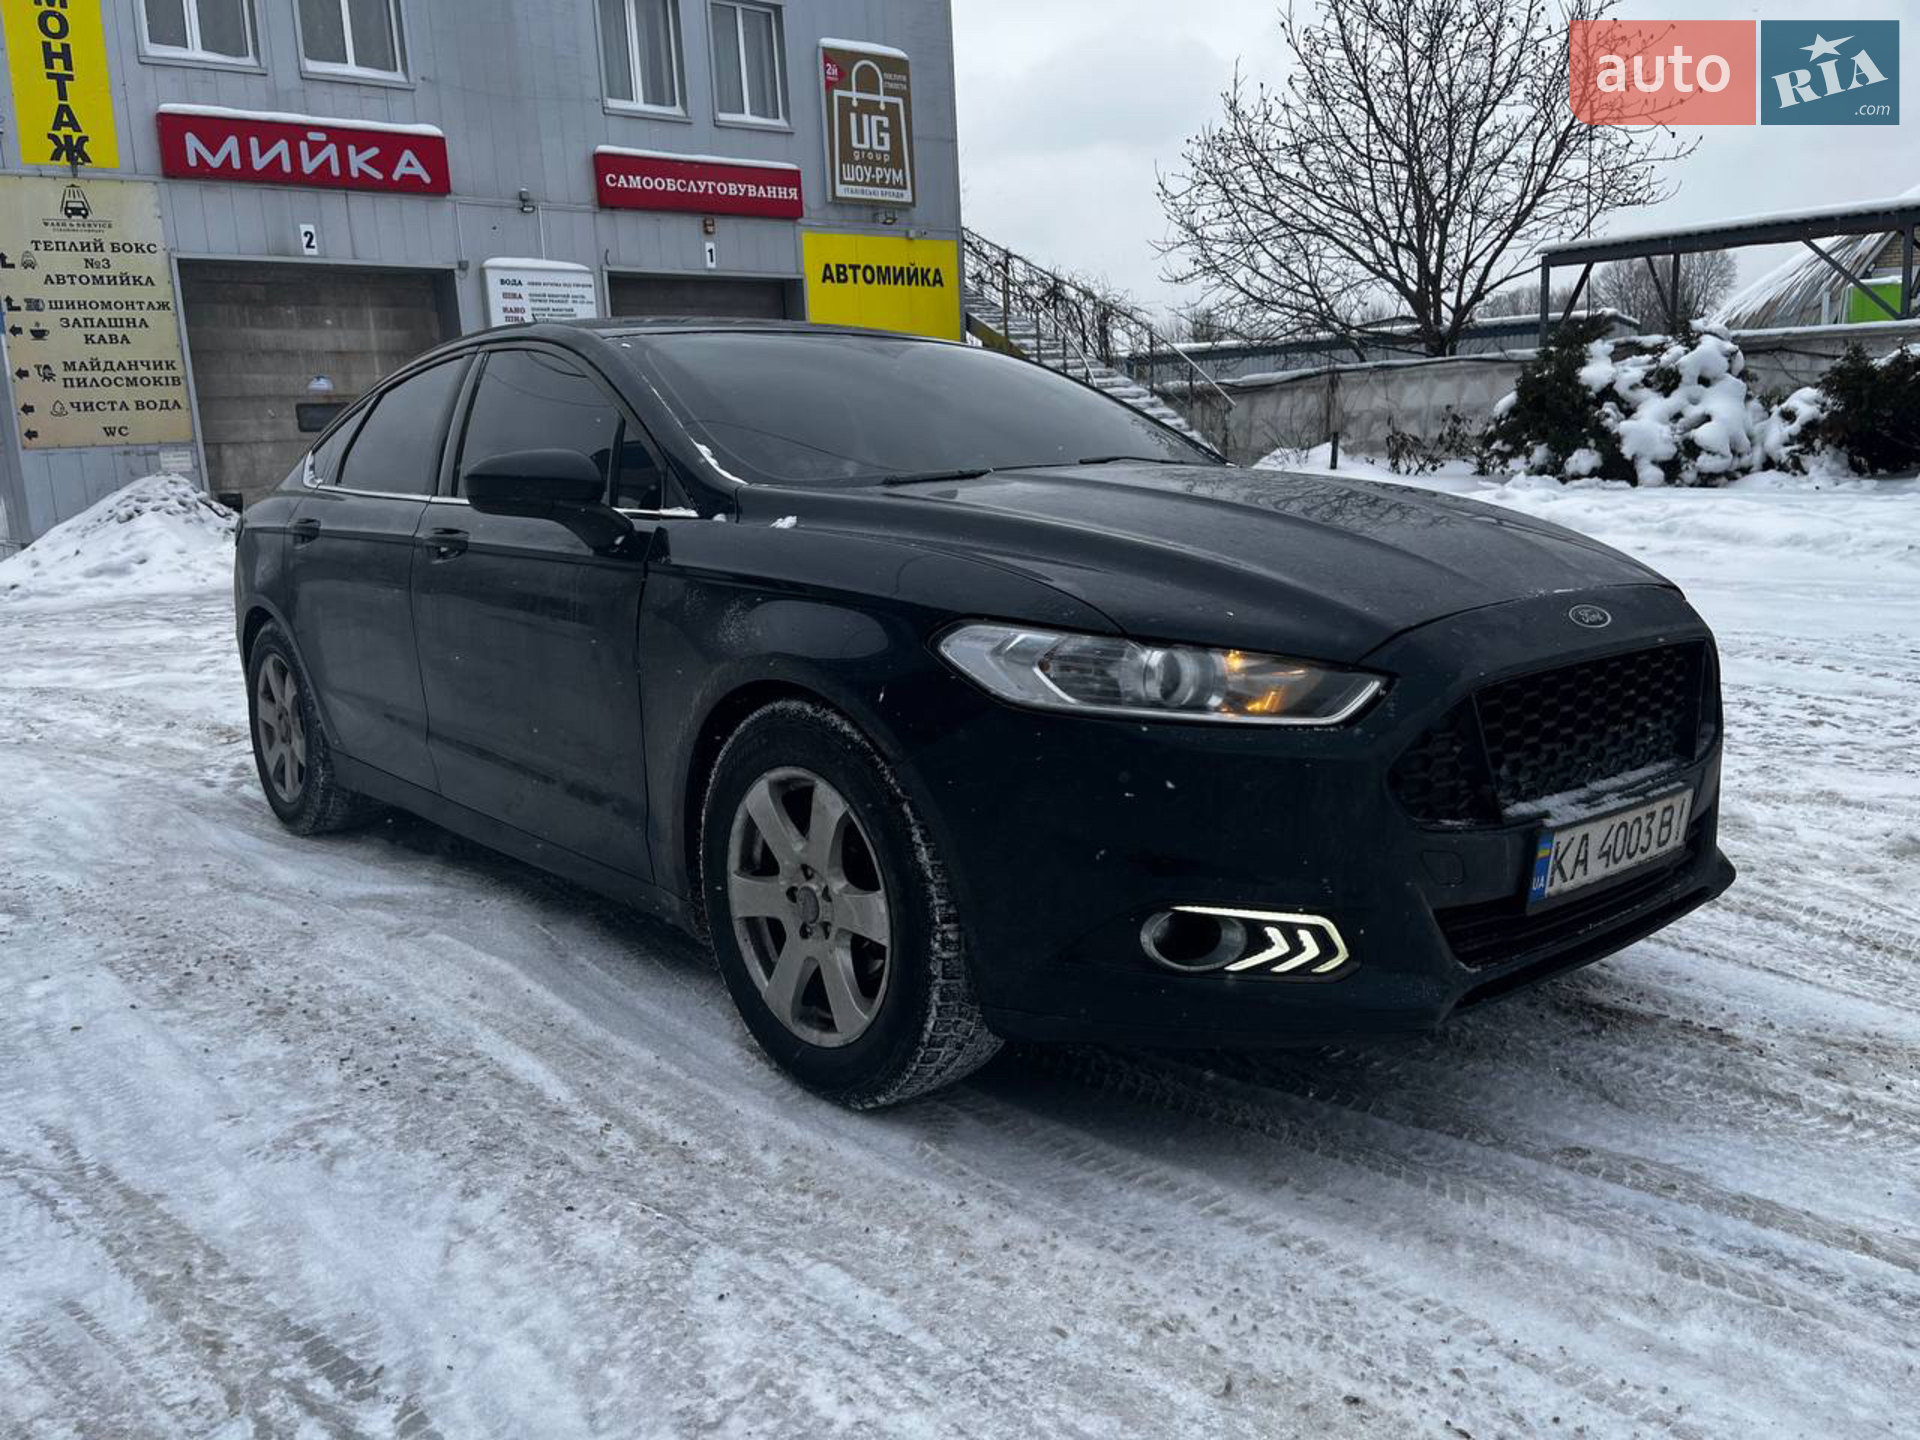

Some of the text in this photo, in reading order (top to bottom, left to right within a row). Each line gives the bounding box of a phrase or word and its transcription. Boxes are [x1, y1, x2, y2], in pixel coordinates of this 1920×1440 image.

[34, 0, 92, 163] ОНТАЖ
[849, 111, 891, 151] UG
[184, 131, 432, 184] МИЙКА
[853, 150, 890, 163] group
[842, 163, 904, 186] ШОУ-РУМ
[605, 173, 799, 200] САМООБСЛУГОВУВАННЯ
[31, 238, 157, 254] ТЕПЛИЙ БОКС
[303, 230, 316, 249] 2
[707, 247, 714, 263] 1
[84, 258, 111, 269] №3
[43, 272, 156, 287] АВТОМИЙКА
[821, 260, 945, 288] АВТОМИЙКА
[500, 278, 523, 287] ВОДА
[48, 300, 171, 311] ШИНОМОНТАЖ
[60, 317, 149, 329] ЗАПАШНА
[84, 334, 131, 345] КАВА
[62, 357, 177, 373] МАЙДАНЧИК
[62, 376, 182, 388] ПИЛОСМОКІВ
[70, 399, 182, 412] ЧИСТА ВОДА
[102, 426, 130, 437] WC
[1549, 832, 1590, 888] KA
[1597, 810, 1657, 869] 4003
[1532, 875, 1546, 891] UA
